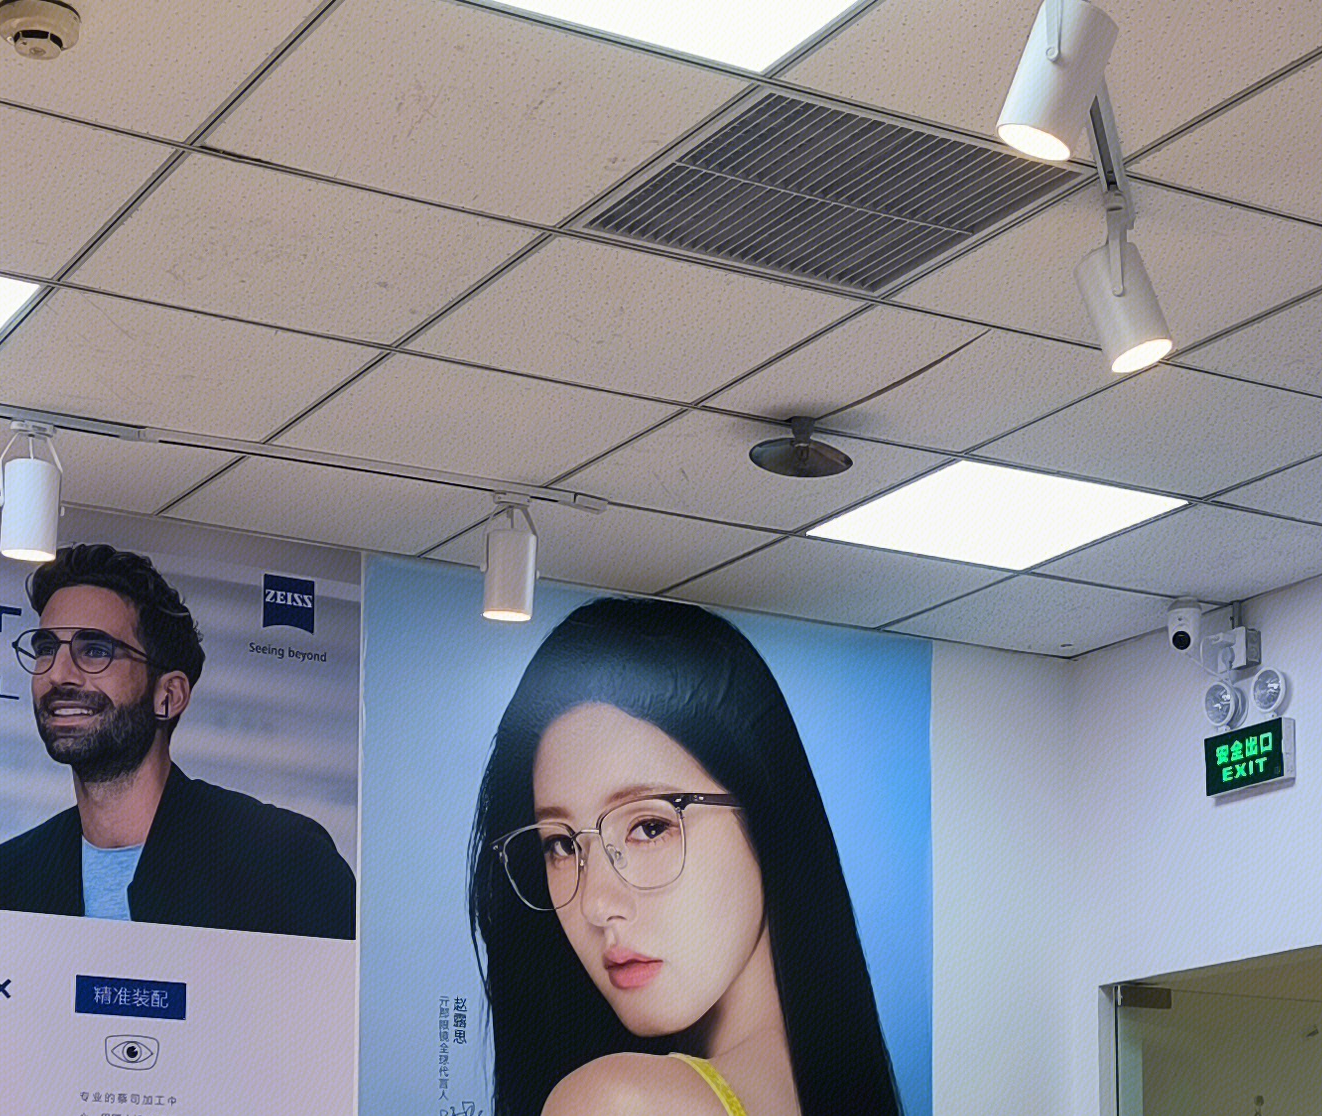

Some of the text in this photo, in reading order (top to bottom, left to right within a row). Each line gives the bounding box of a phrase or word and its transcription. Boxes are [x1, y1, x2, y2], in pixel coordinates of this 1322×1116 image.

[264, 588, 313, 608] ZEISS
[248, 641, 327, 663] Seeing beyond
[1215, 731, 1273, 766] 安全出口
[1222, 756, 1268, 783] EXIT
[93, 985, 169, 1009] 精准装配
[453, 994, 467, 1045] 赵露思
[79, 1091, 177, 1107] 专业的蔡司加工中
